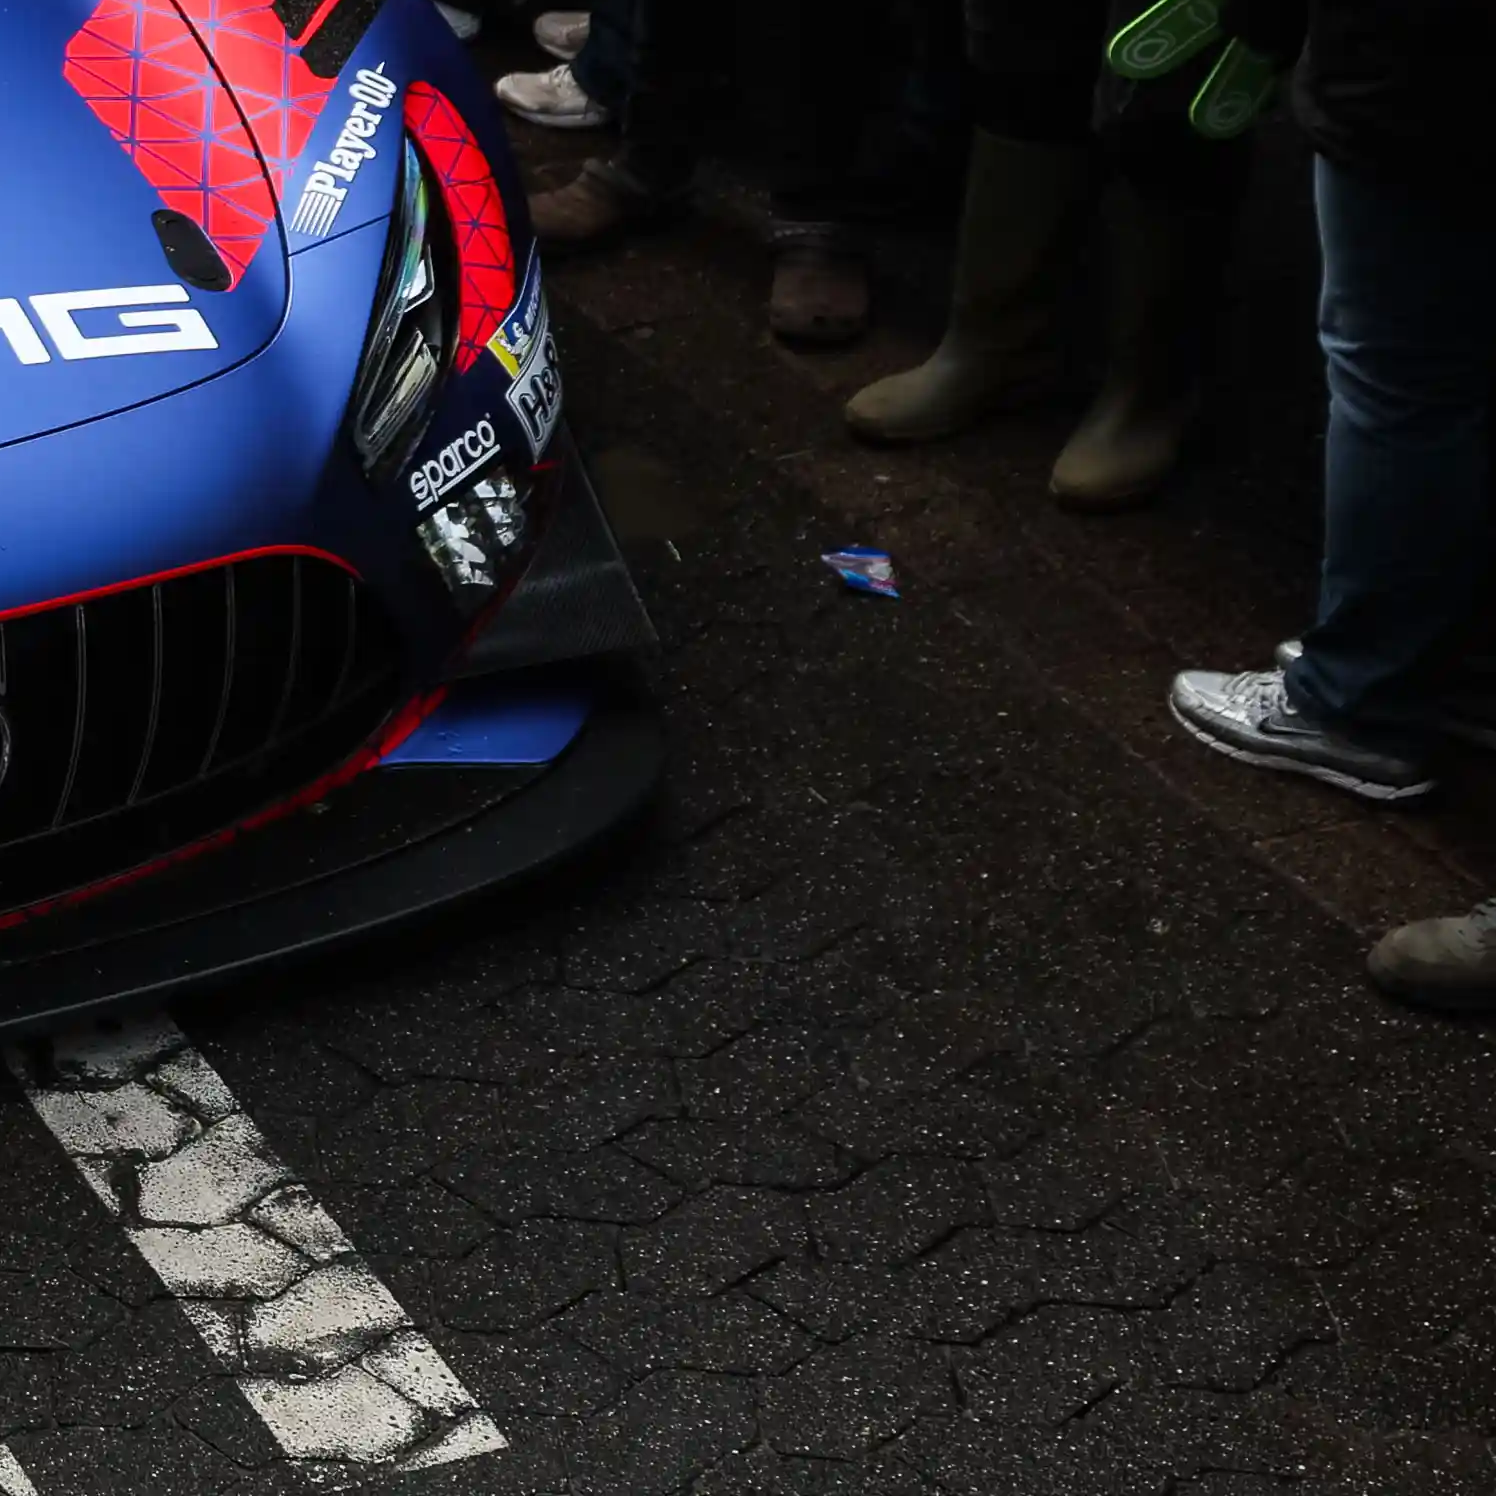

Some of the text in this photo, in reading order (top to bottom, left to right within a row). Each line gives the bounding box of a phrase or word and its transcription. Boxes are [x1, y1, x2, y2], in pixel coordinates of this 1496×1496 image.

[308, 66, 398, 199] Player 0.0
[409, 418, 497, 504] sparco
